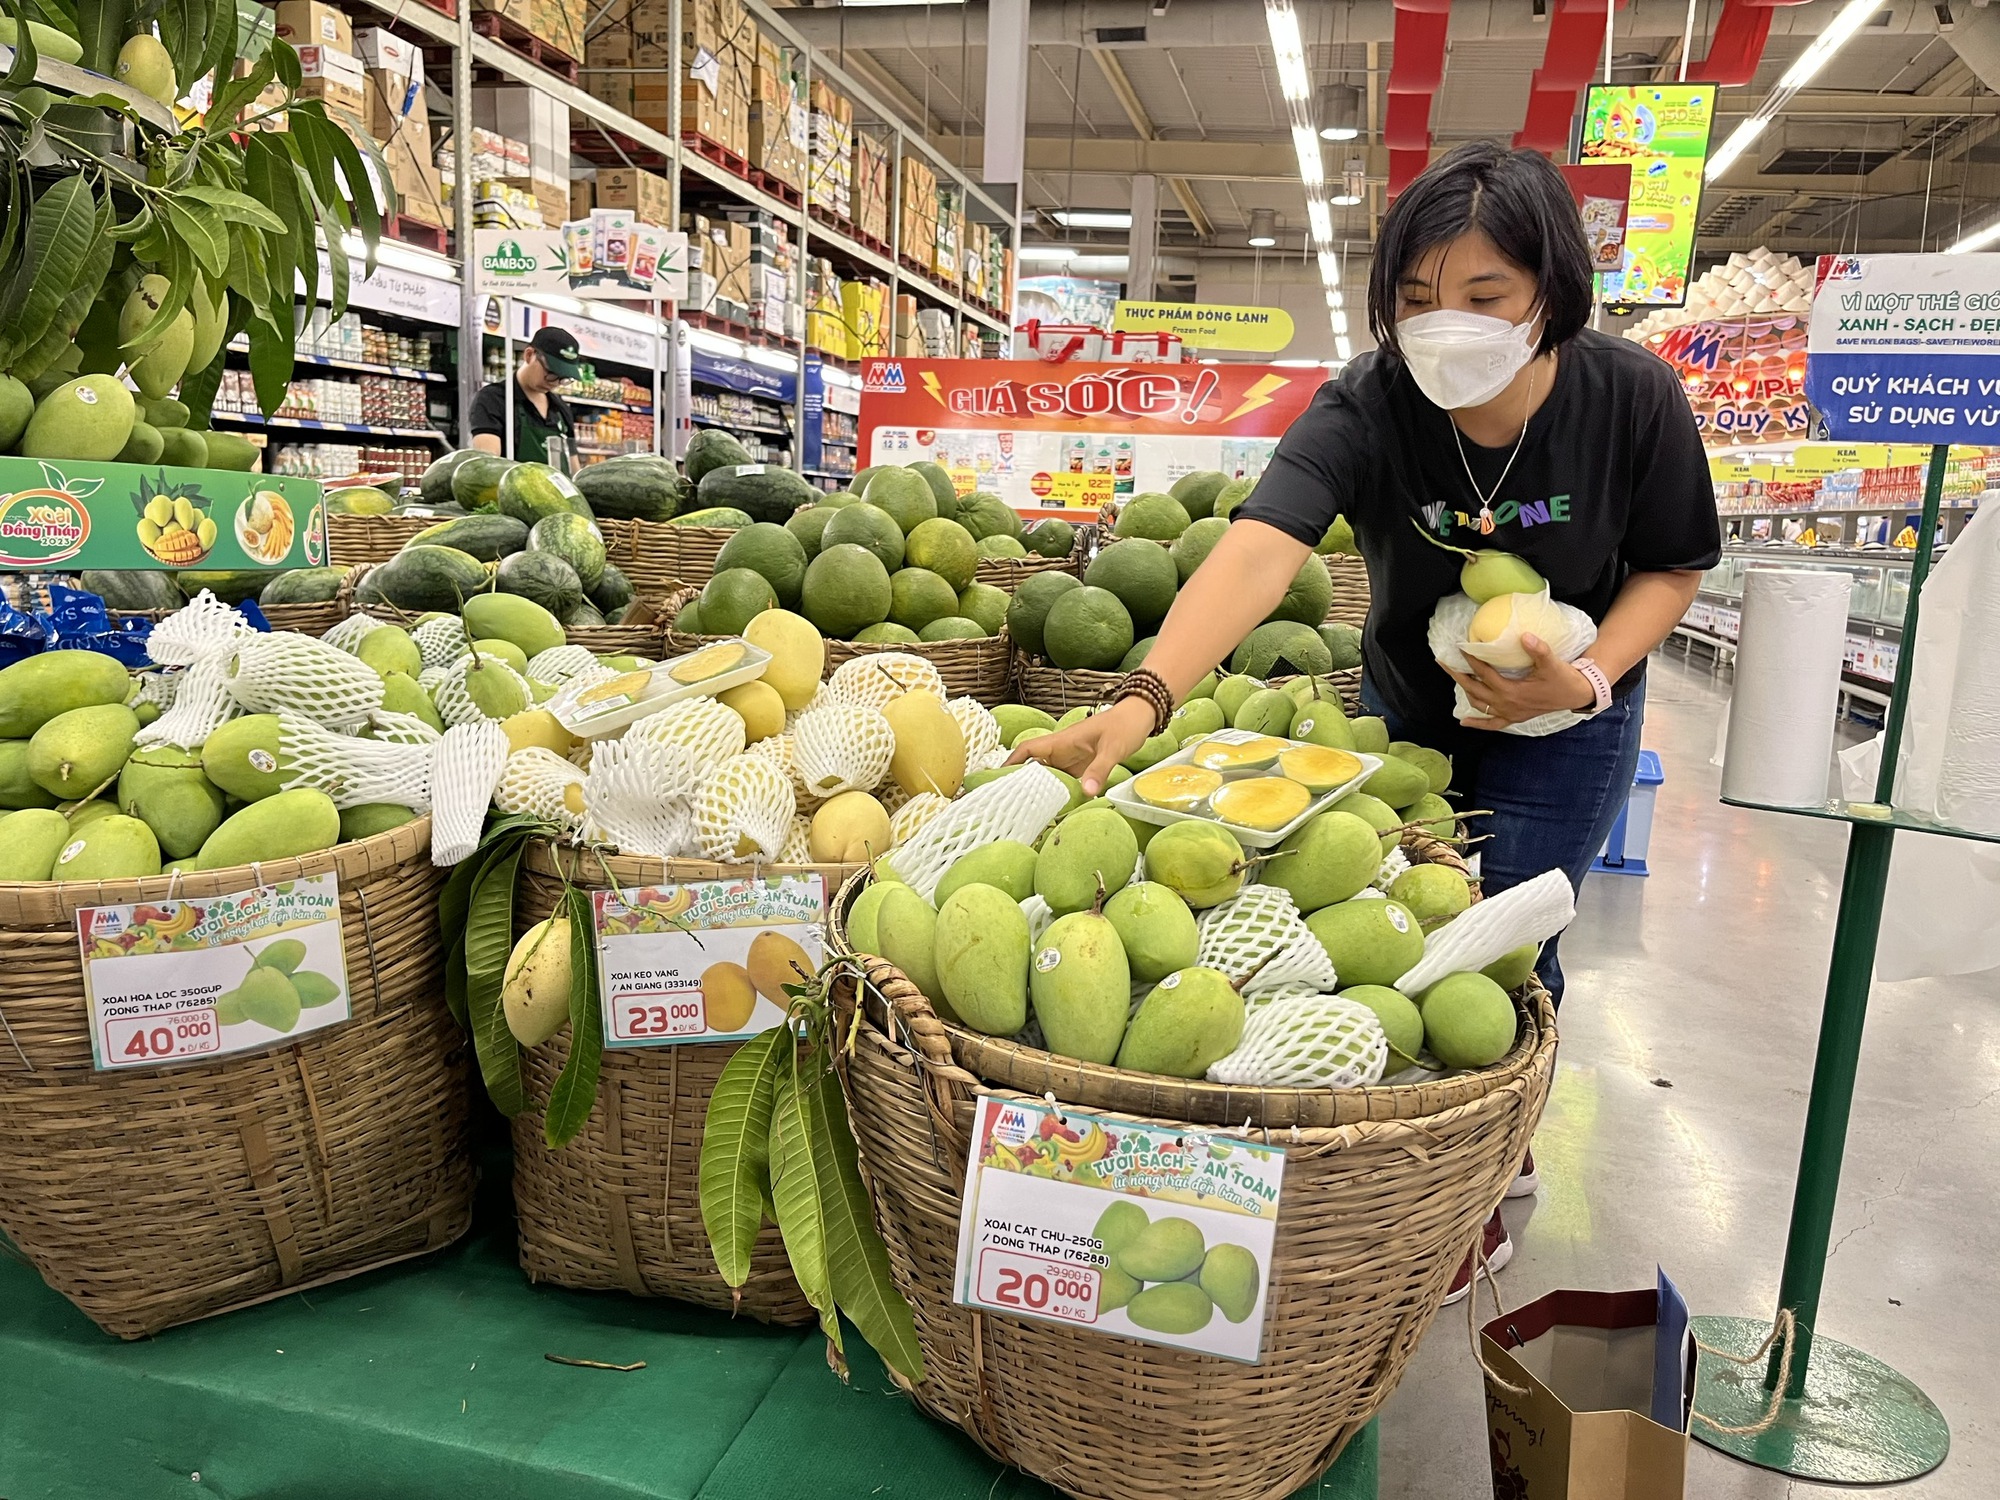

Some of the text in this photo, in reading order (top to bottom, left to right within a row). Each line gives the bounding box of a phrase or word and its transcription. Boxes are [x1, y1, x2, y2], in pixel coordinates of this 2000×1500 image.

[483, 256, 536, 271] BAMBOO
[1841, 291, 1862, 311] VÌ
[1866, 293, 1913, 314] MỘT
[1125, 308, 1154, 321] THỰC
[1158, 307, 1192, 320] PHẨM
[1236, 312, 1268, 325] LẠNH
[1838, 318, 1888, 331] XANH
[1904, 318, 1954, 334] SẠCH
[1172, 326, 1197, 334] Frozen
[1861, 338, 1892, 346] NYLON
[1926, 338, 1948, 346] SAVE
[1952, 338, 1969, 346] THE
[1971, 338, 2000, 346] WORL
[1831, 372, 1881, 396] QUÝ
[1887, 373, 1969, 396] KHÁCH
[949, 379, 1017, 414] GIÁ
[1716, 408, 1770, 433] Quý
[1848, 401, 1883, 424] SỬ
[1890, 407, 1955, 428] DỤNG
[1081, 492, 1098, 506] 99
[2, 520, 81, 541] Đồng Tháp
[41, 537, 71, 546] 2023
[227, 903, 261, 923] SẠCH
[300, 894, 334, 908] TOÀN
[717, 892, 749, 910] SẠCH
[611, 969, 679, 981] XOAI KEO VANG
[620, 983, 632, 991] AN
[635, 981, 662, 990] GIANG
[664, 979, 702, 990] (333149)
[102, 984, 222, 1005] XOAI HOA LOC 350GUP
[104, 996, 217, 1016] /DONG THAP (76285)
[1138, 1153, 1184, 1171] SẠCH
[1203, 1162, 1228, 1180] AN
[1234, 1170, 1278, 1202] TOÀN
[984, 1218, 1103, 1249] XOAI CAT CHU-250G
[992, 1234, 1024, 1249] DONG
[1029, 1241, 1060, 1255] THAP
[1064, 1248, 1110, 1268] (76288)
[996, 1268, 1092, 1308] 20 000
